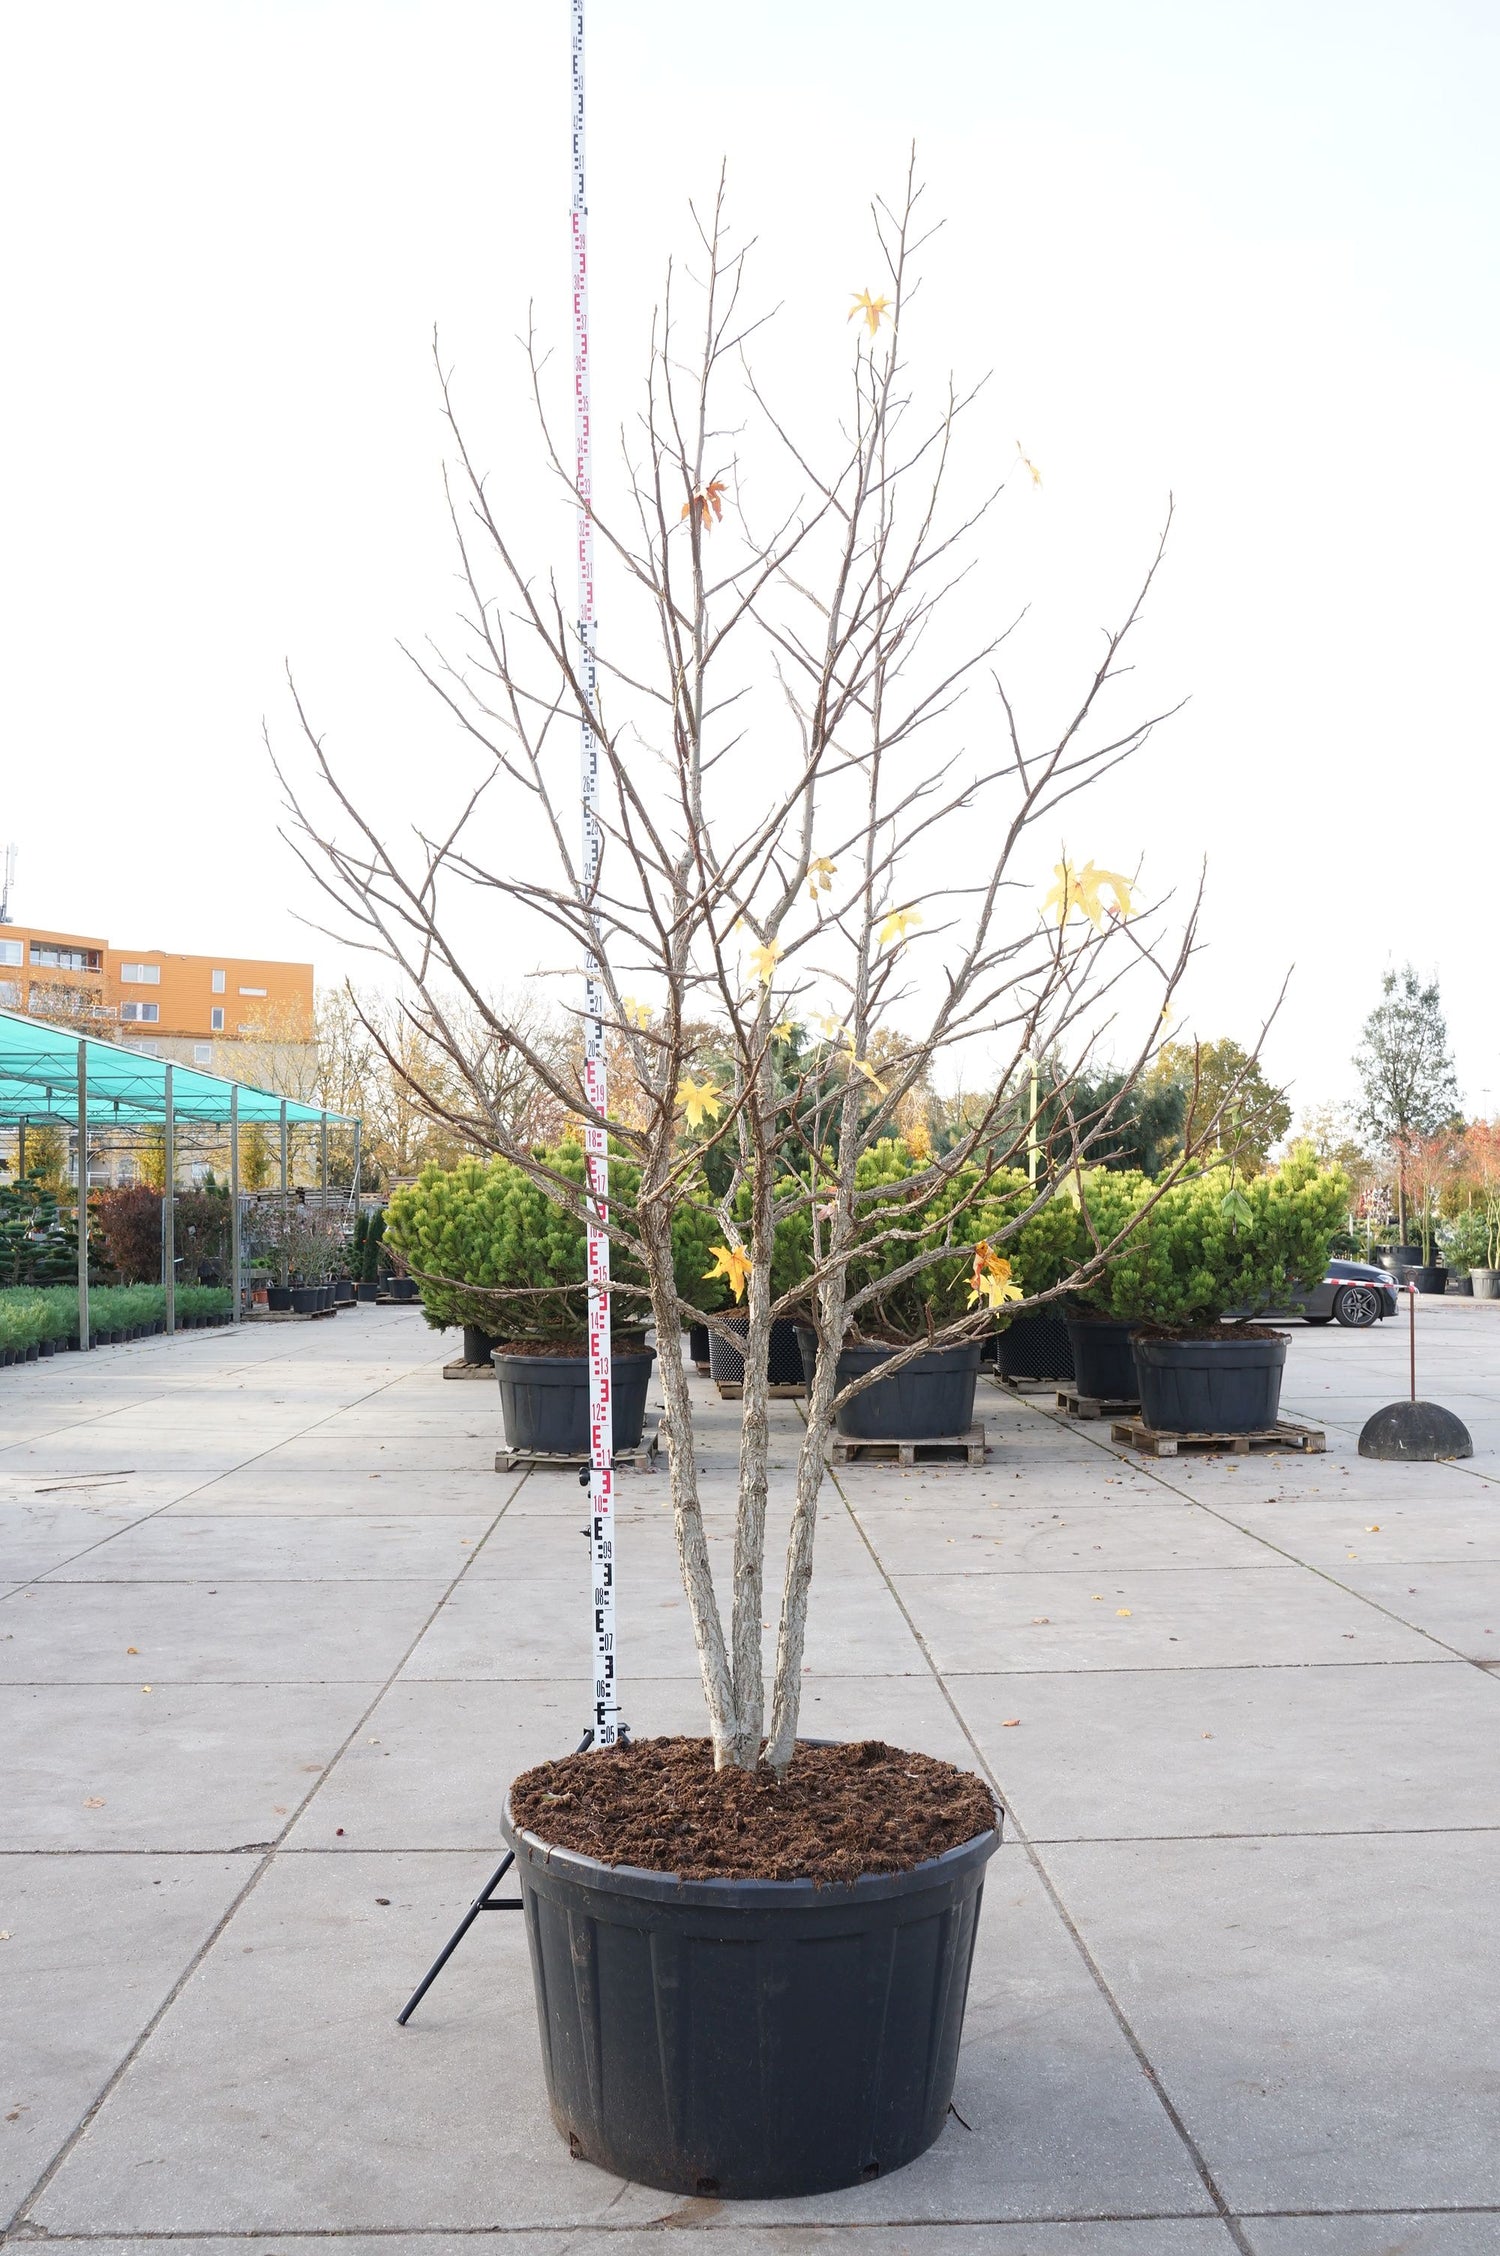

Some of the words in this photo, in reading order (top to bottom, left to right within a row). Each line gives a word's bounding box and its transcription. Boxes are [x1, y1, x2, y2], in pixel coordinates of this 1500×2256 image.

[583, 776, 590, 792] 26
[585, 863, 591, 880] 24
[595, 996, 602, 1012] 21
[588, 1040, 595, 1057] 20
[596, 1084, 604, 1102] 19
[588, 1130, 596, 1148] 18
[598, 1174, 605, 1192] 17
[599, 1266, 607, 1282] 15
[591, 1312, 598, 1329] 14
[600, 1357, 608, 1375] 13
[592, 1403, 600, 1420] 12
[602, 1449, 610, 1466] 11
[594, 1495, 602, 1512] 10
[603, 1541, 612, 1559] 09
[595, 1587, 603, 1605] 08
[605, 1634, 613, 1651] 07
[597, 1680, 605, 1698] 06
[606, 1726, 614, 1744] 05
